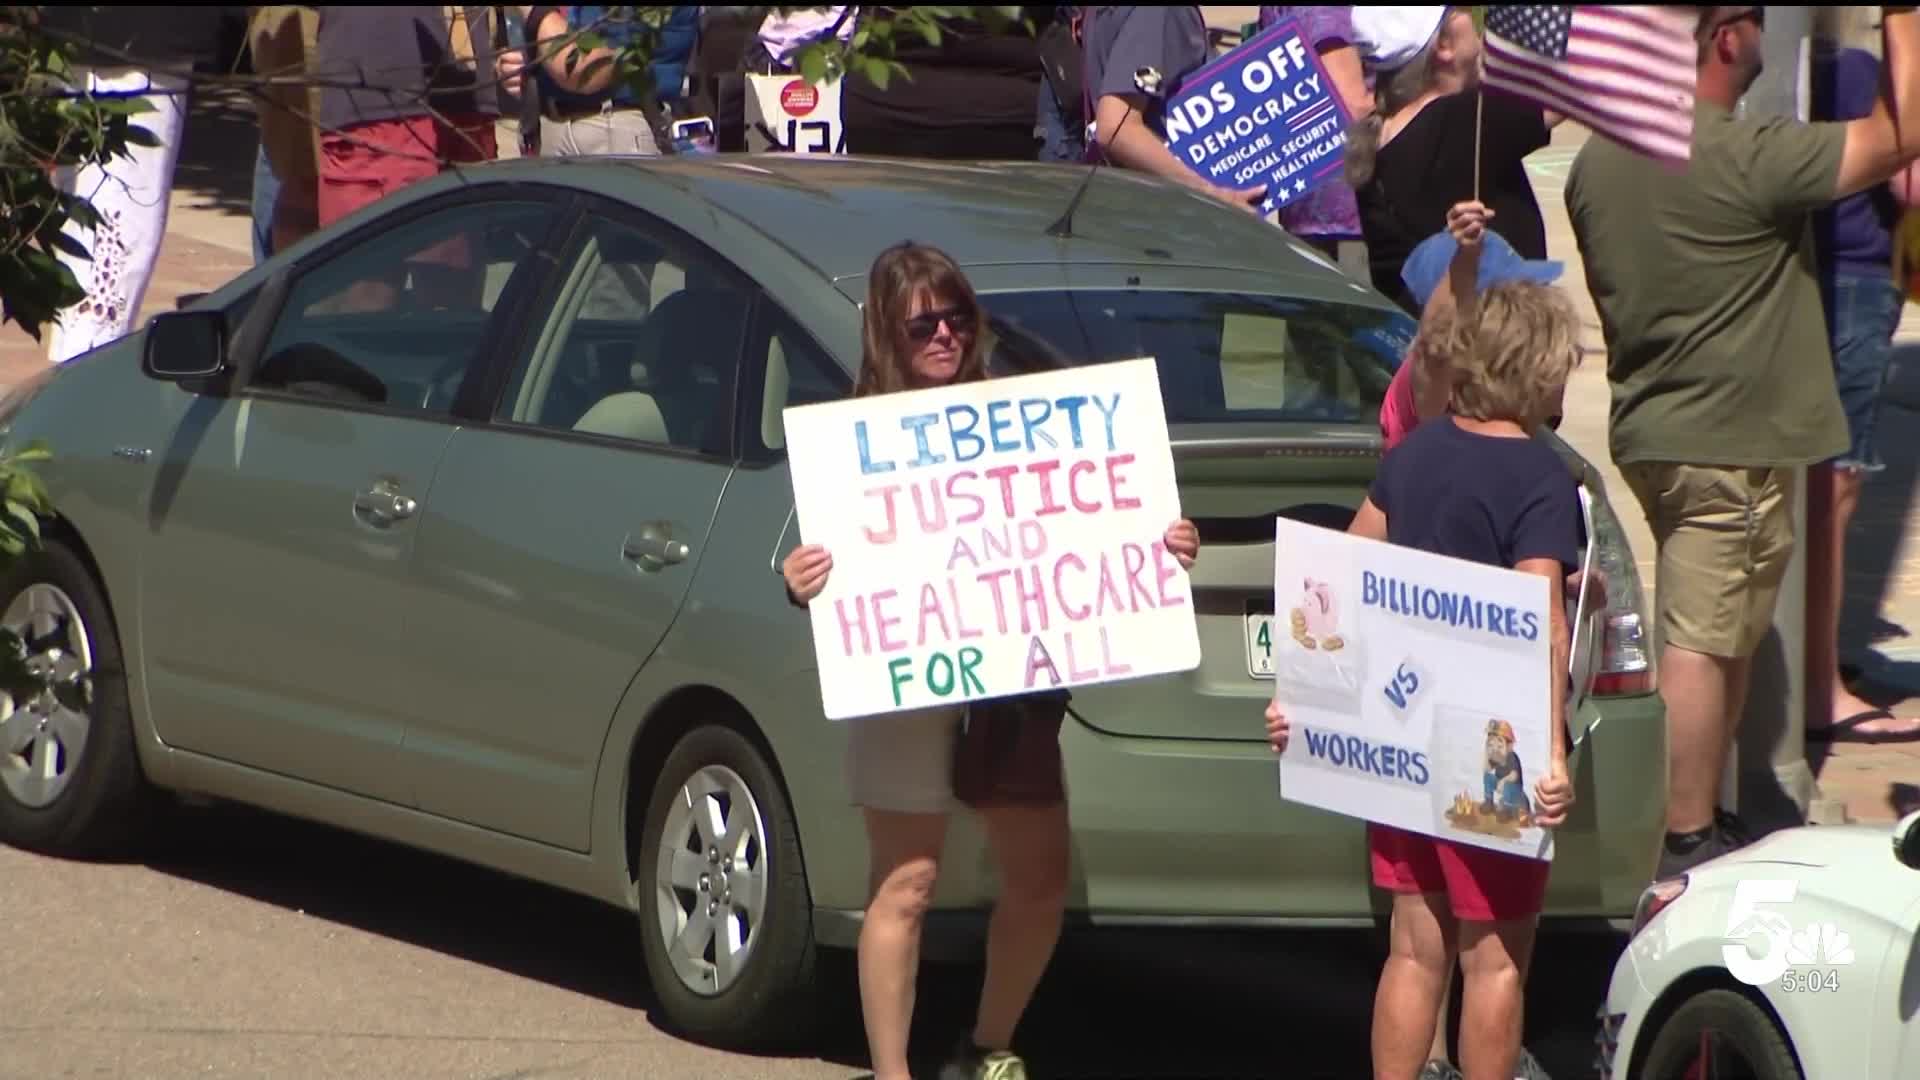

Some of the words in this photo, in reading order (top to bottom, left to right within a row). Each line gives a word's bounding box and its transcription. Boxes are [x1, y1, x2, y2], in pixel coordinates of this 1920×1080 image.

[1165, 81, 1236, 144] NDS
[1241, 36, 1305, 94] OFF
[1188, 73, 1320, 165] DEMOCRACY
[1209, 133, 1272, 177] MEDICARE
[1234, 152, 1281, 184] SOCIAL
[1281, 116, 1338, 157] SECURITY
[855, 393, 1121, 475] LIBERTY
[861, 454, 1142, 544] JUSTICE
[946, 519, 1049, 570] AND
[834, 541, 1185, 656] HEALTHCARE
[1362, 570, 1539, 642] BILLIONAIRES
[888, 646, 986, 706] FOR
[1023, 626, 1132, 689] ALL
[1384, 663, 1419, 709] VS
[1303, 727, 1430, 785] WORKERS
